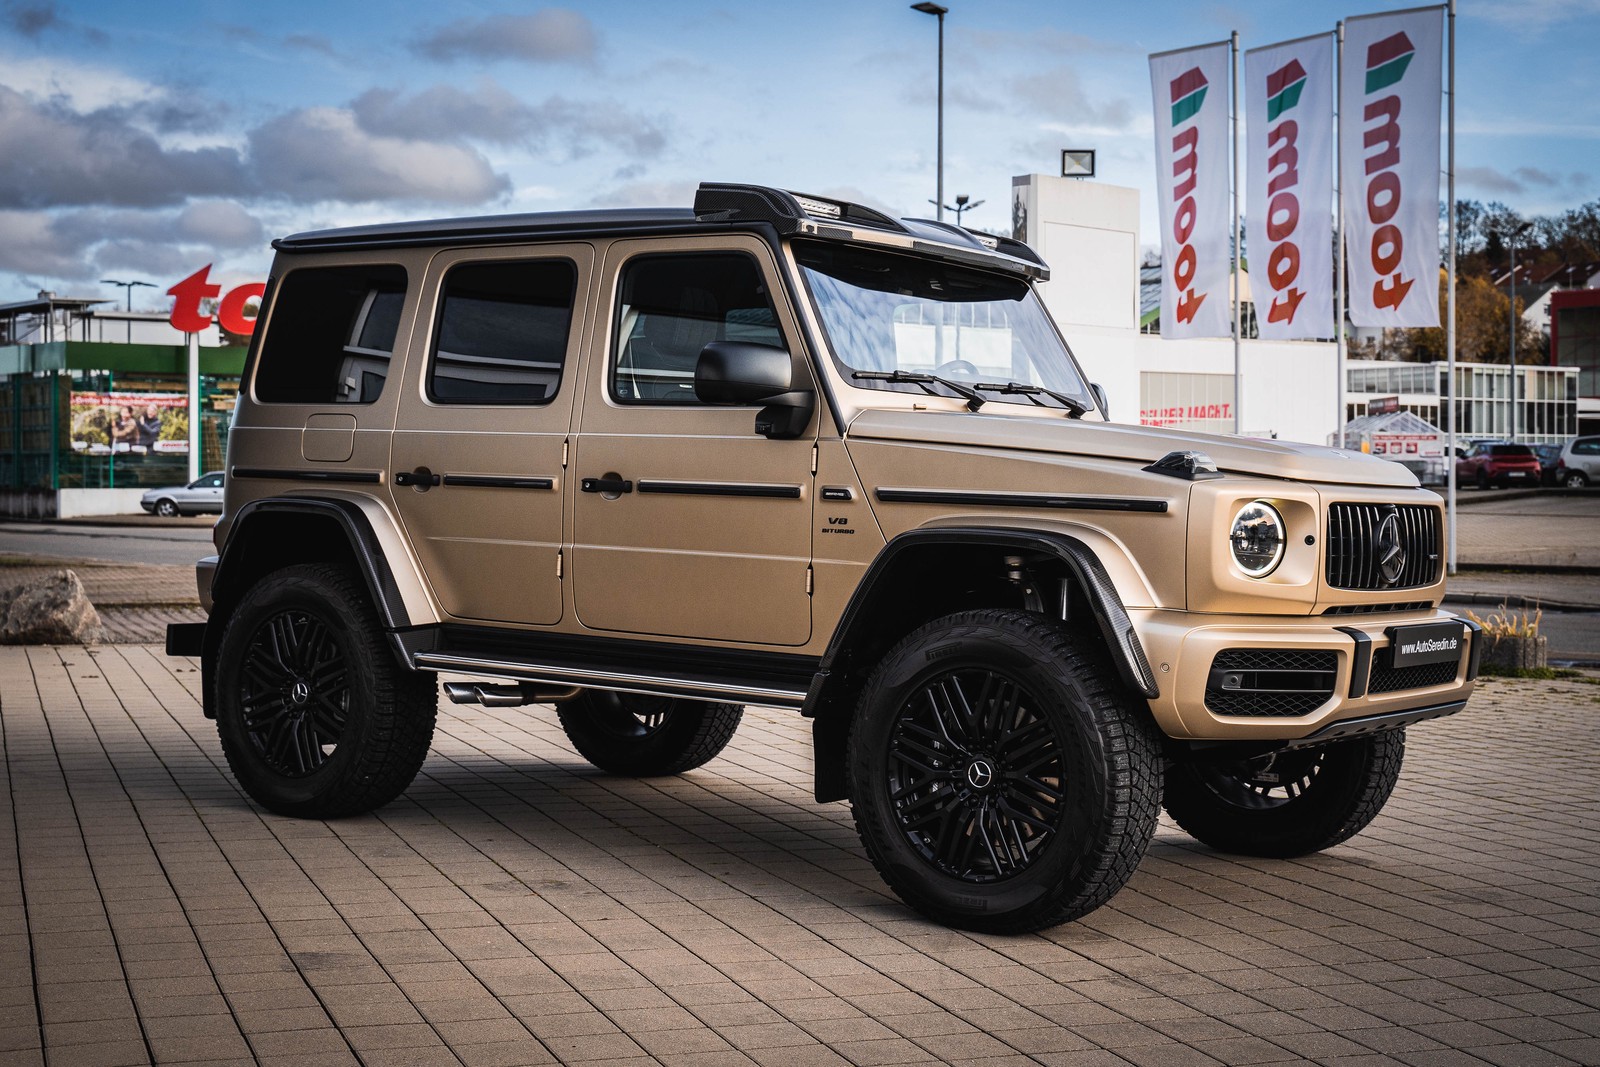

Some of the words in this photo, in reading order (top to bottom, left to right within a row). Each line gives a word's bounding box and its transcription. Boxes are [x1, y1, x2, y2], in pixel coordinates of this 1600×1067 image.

[1172, 125, 1208, 325] toom
[1267, 119, 1307, 325] toom
[1364, 95, 1414, 310] toom
[1401, 638, 1457, 654] www.AutoSeredin.de
